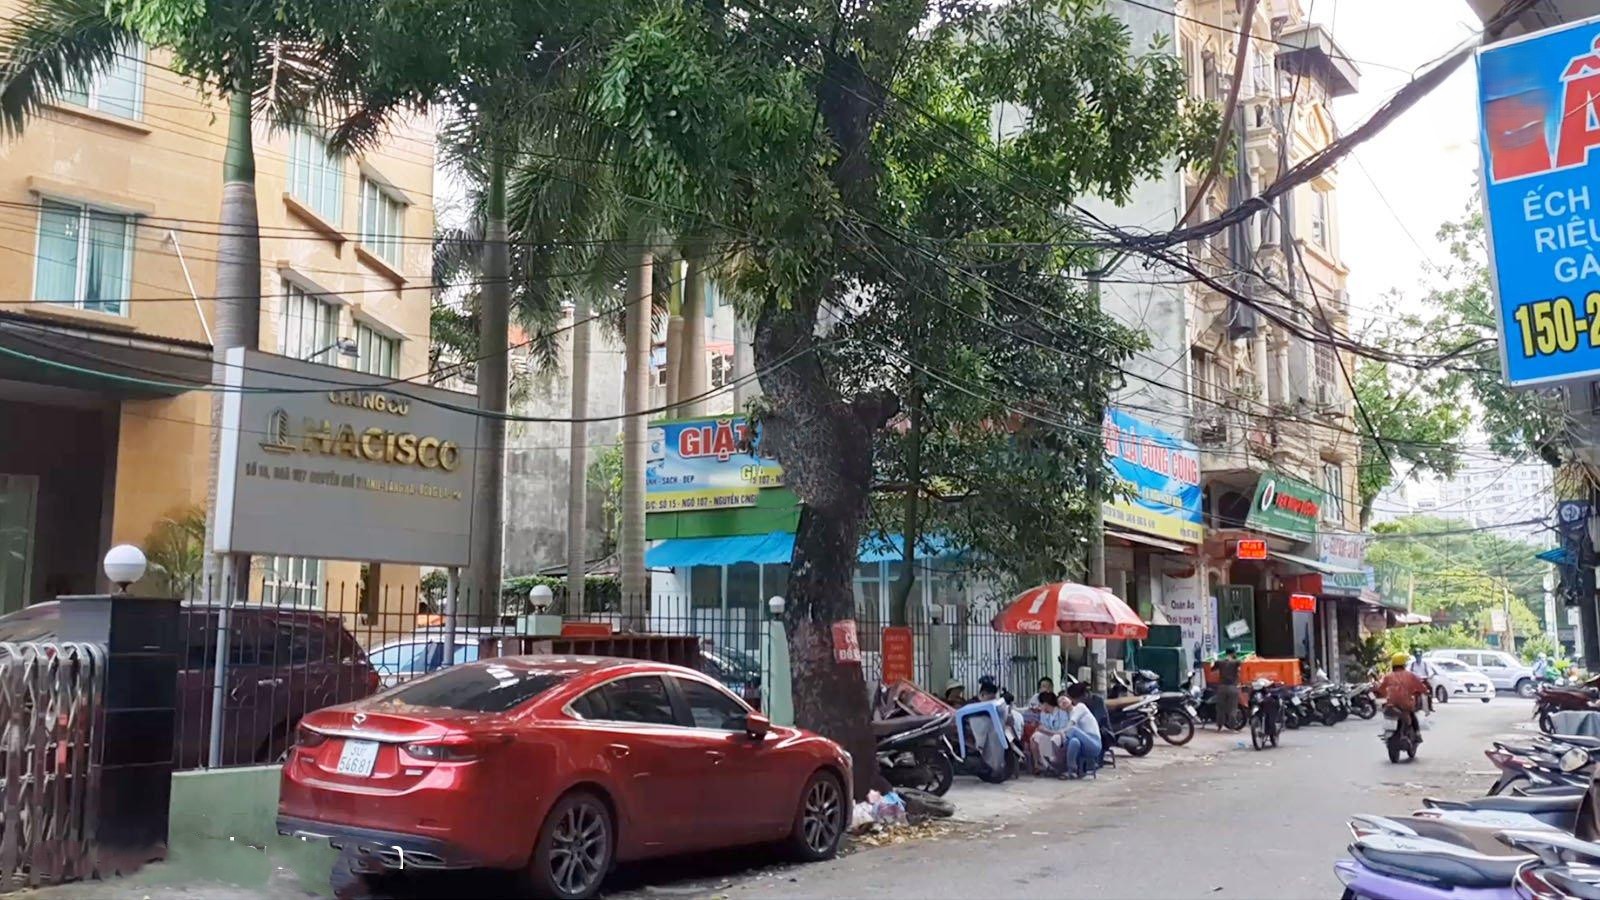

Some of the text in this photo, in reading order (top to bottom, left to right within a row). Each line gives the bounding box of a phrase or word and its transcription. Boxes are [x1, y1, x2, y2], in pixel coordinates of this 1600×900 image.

[1523, 184, 1591, 222] ẾCH
[1554, 245, 1600, 283] GÀ
[302, 416, 461, 472] HACISCO
